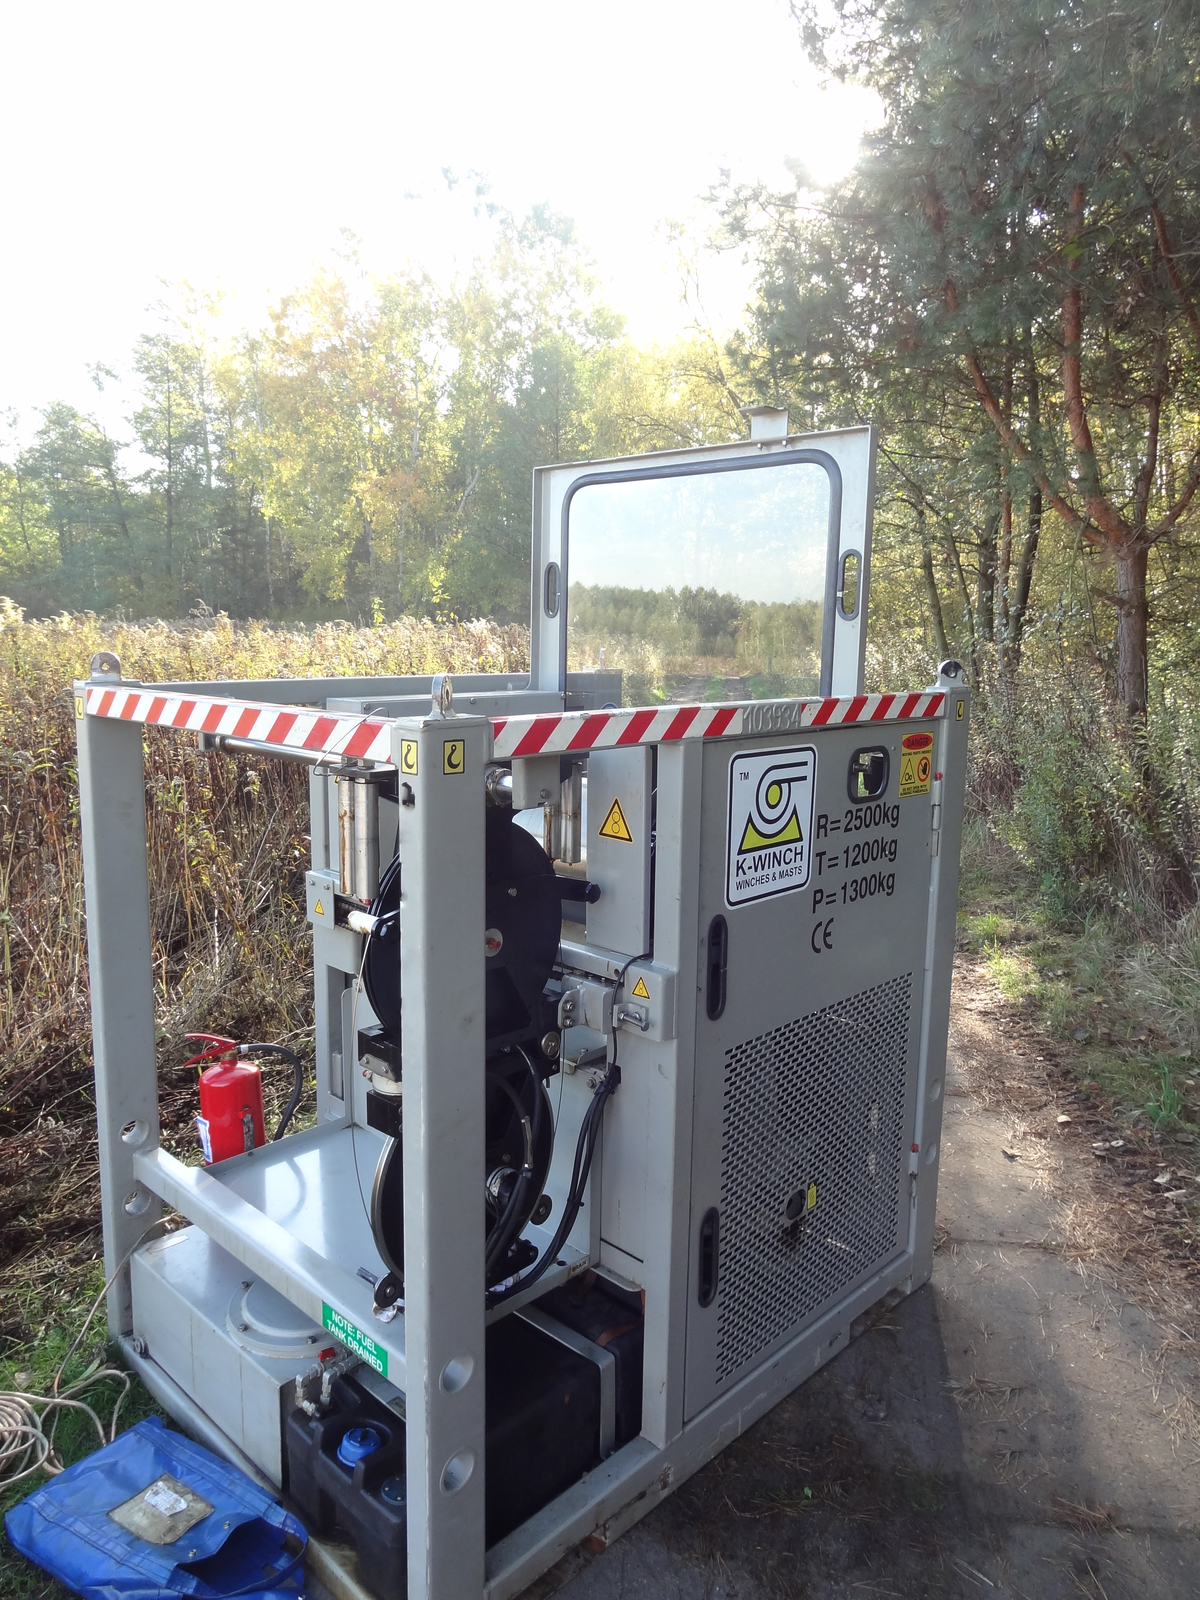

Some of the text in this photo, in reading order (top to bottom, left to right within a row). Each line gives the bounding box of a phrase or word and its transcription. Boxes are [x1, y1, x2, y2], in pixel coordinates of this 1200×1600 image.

[743, 703, 800, 734] 103934
[907, 736, 929, 748] DANGER
[739, 772, 749, 781] TM
[736, 845, 804, 877] K-WINCH
[735, 865, 803, 891] WINCHES & MASTS
[811, 917, 834, 953] CE
[327, 1319, 383, 1372] TANK DRAINED
[332, 1311, 377, 1354] NOTE: FUEL
